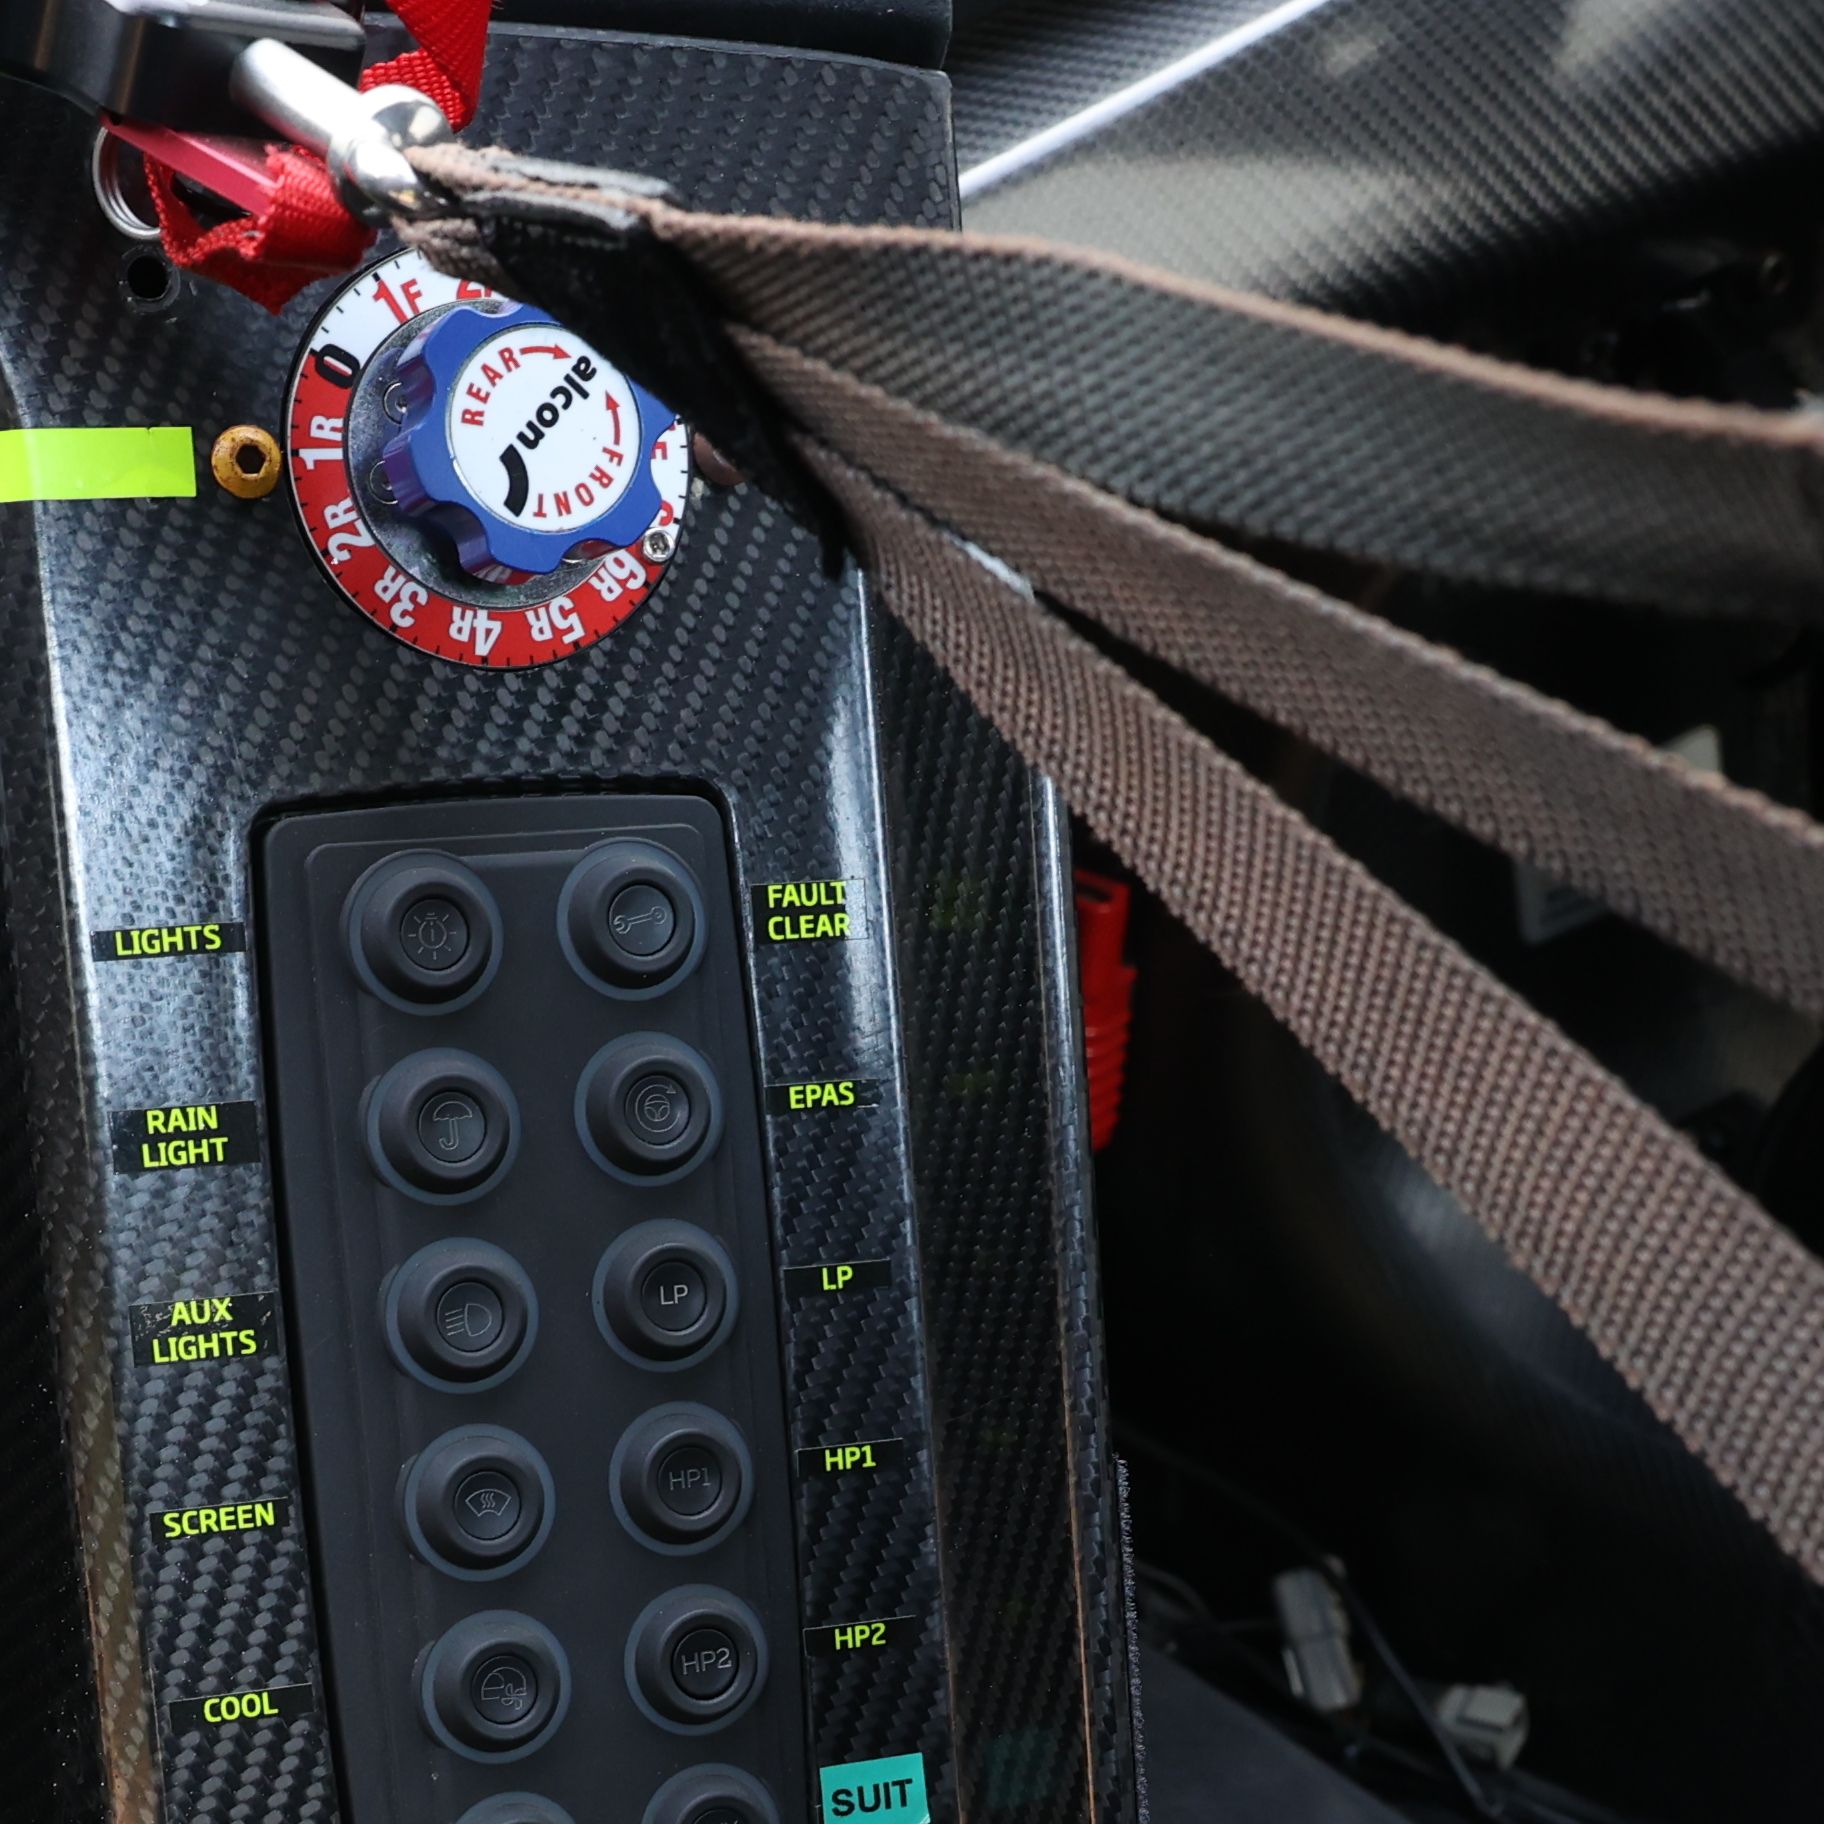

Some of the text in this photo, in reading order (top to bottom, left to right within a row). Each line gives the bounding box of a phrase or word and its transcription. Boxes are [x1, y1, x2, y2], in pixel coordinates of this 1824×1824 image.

[459, 346, 521, 428] REAR
[516, 354, 597, 452] alcon
[297, 412, 346, 471] 1R
[532, 446, 624, 519] FRONT
[323, 498, 378, 562] 2R
[373, 568, 428, 629] 3R
[448, 604, 504, 656] 4R
[527, 597, 586, 646] 5R
[766, 879, 847, 908] FAULT
[114, 922, 222, 956] LIGHTS
[766, 911, 850, 941] CLEAR
[788, 1081, 855, 1110] EPAS
[146, 1105, 218, 1134] RAIN
[140, 1135, 229, 1169] LIGHT
[659, 1283, 690, 1305] LP
[821, 1265, 853, 1291] LP
[170, 1295, 234, 1325] AUX
[152, 1328, 257, 1365] LIGHTS
[823, 1444, 877, 1472] HP1
[668, 1466, 712, 1493] HP1
[162, 1502, 276, 1538] SCREEN
[833, 1621, 887, 1650] HP2
[681, 1647, 733, 1674] HP2
[202, 1690, 280, 1724] COOL
[830, 1779, 915, 1817] SUIT
